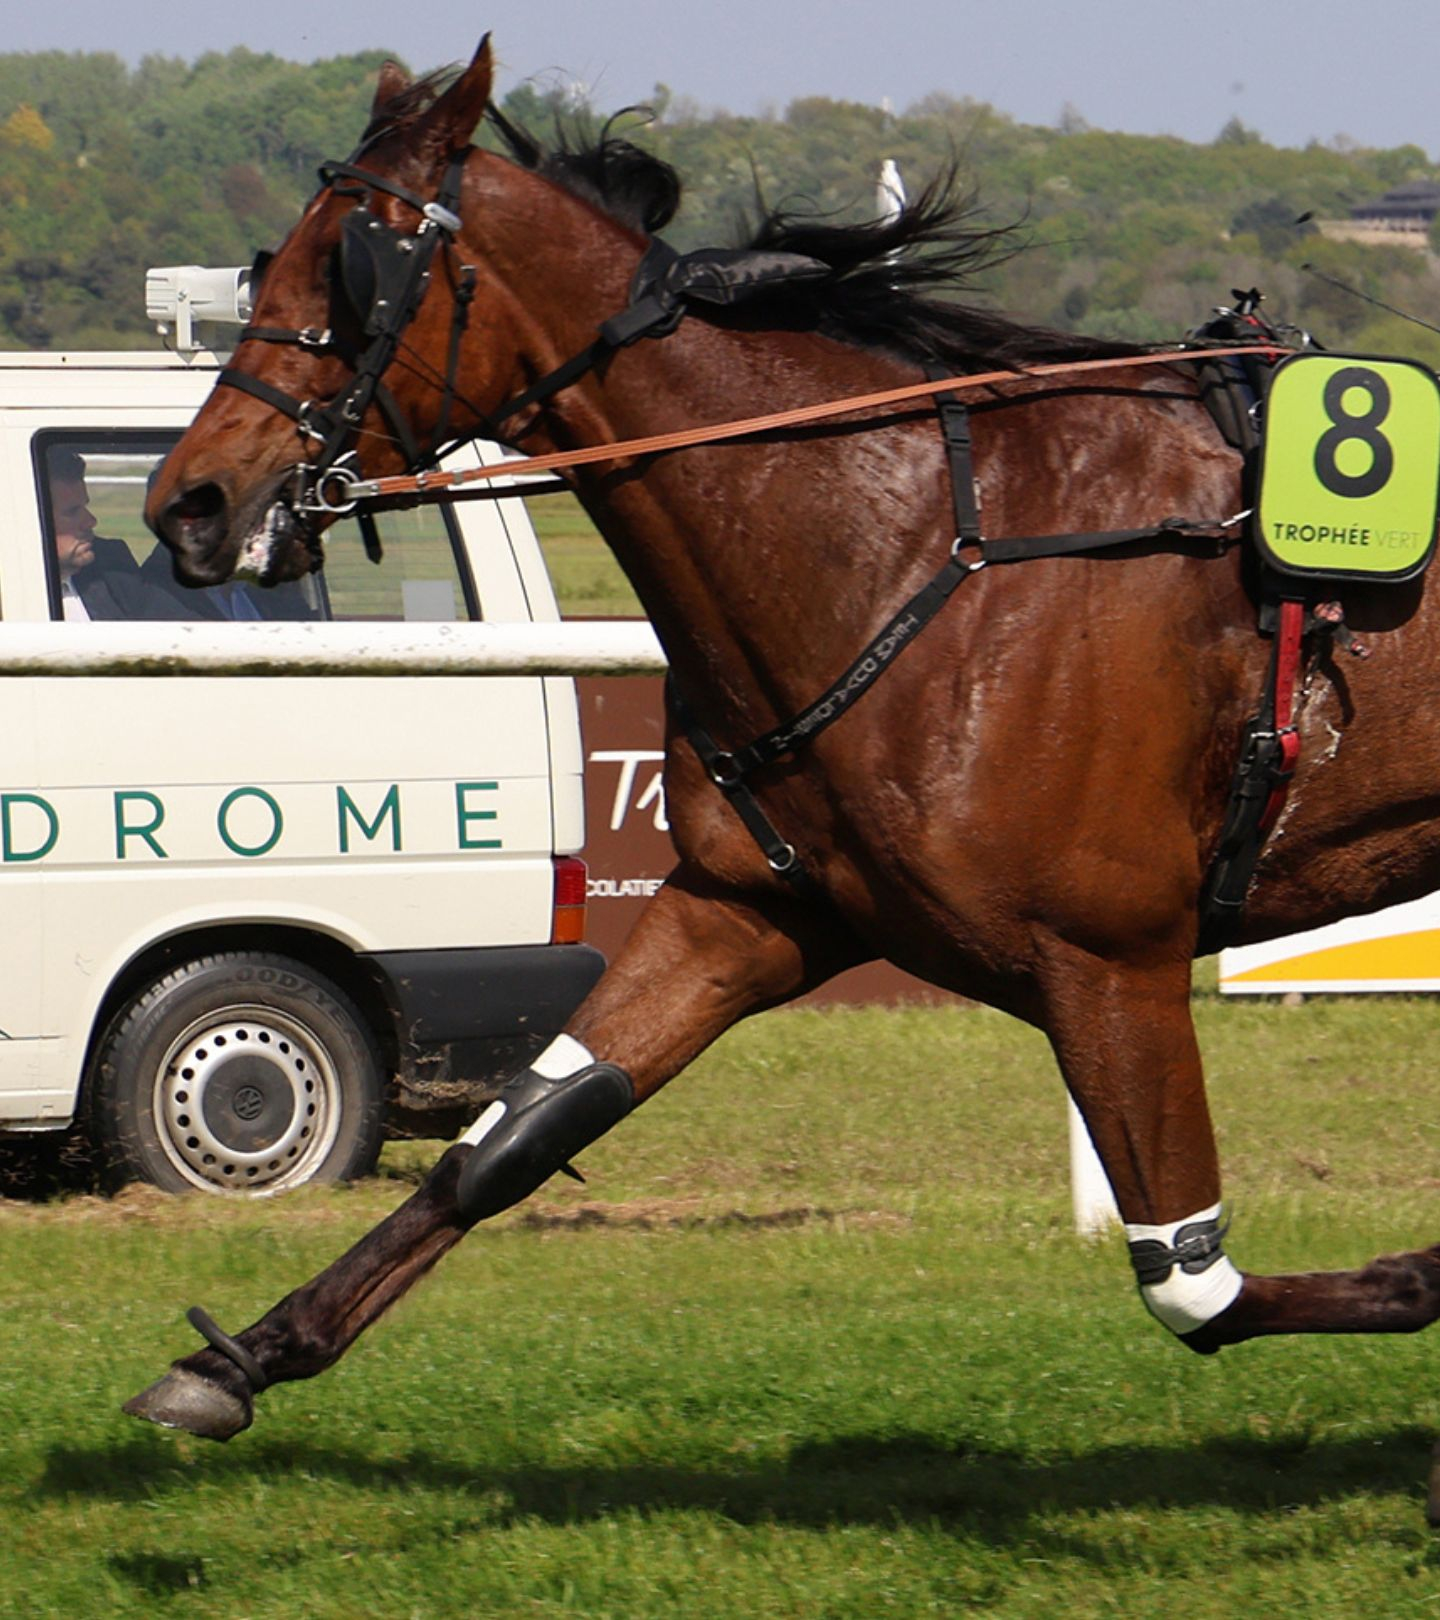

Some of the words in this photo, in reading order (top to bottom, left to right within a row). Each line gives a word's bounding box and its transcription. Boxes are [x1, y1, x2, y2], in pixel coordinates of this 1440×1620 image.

[1313, 366, 1395, 499] 8
[1272, 522, 1371, 546] TROPHÉE
[1374, 530, 1421, 550] VERT
[873, 612, 920, 662] TEAM
[0, 781, 503, 863] DROME
